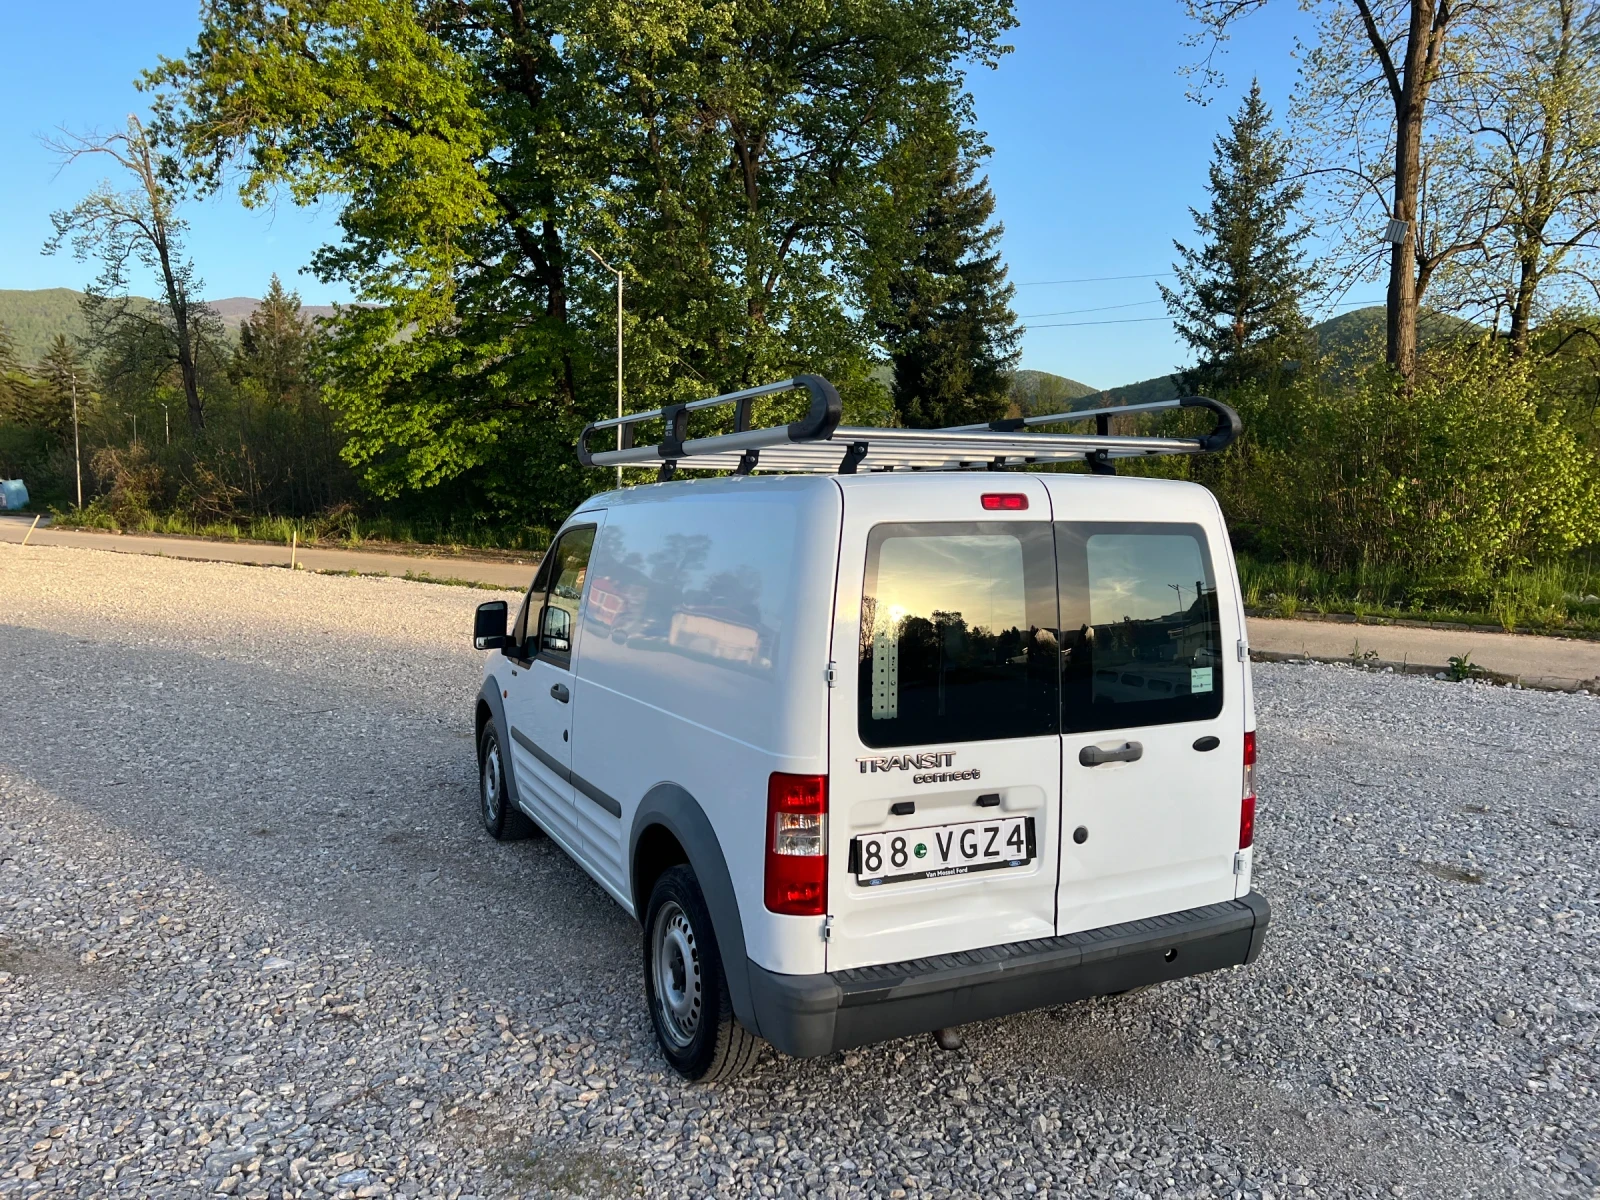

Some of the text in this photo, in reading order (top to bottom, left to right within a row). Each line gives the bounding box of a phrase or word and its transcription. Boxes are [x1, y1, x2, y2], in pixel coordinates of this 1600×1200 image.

[855, 751, 957, 773] TRANSIT
[913, 768, 981, 784] connect
[865, 824, 1024, 872] 88 VGZ4
